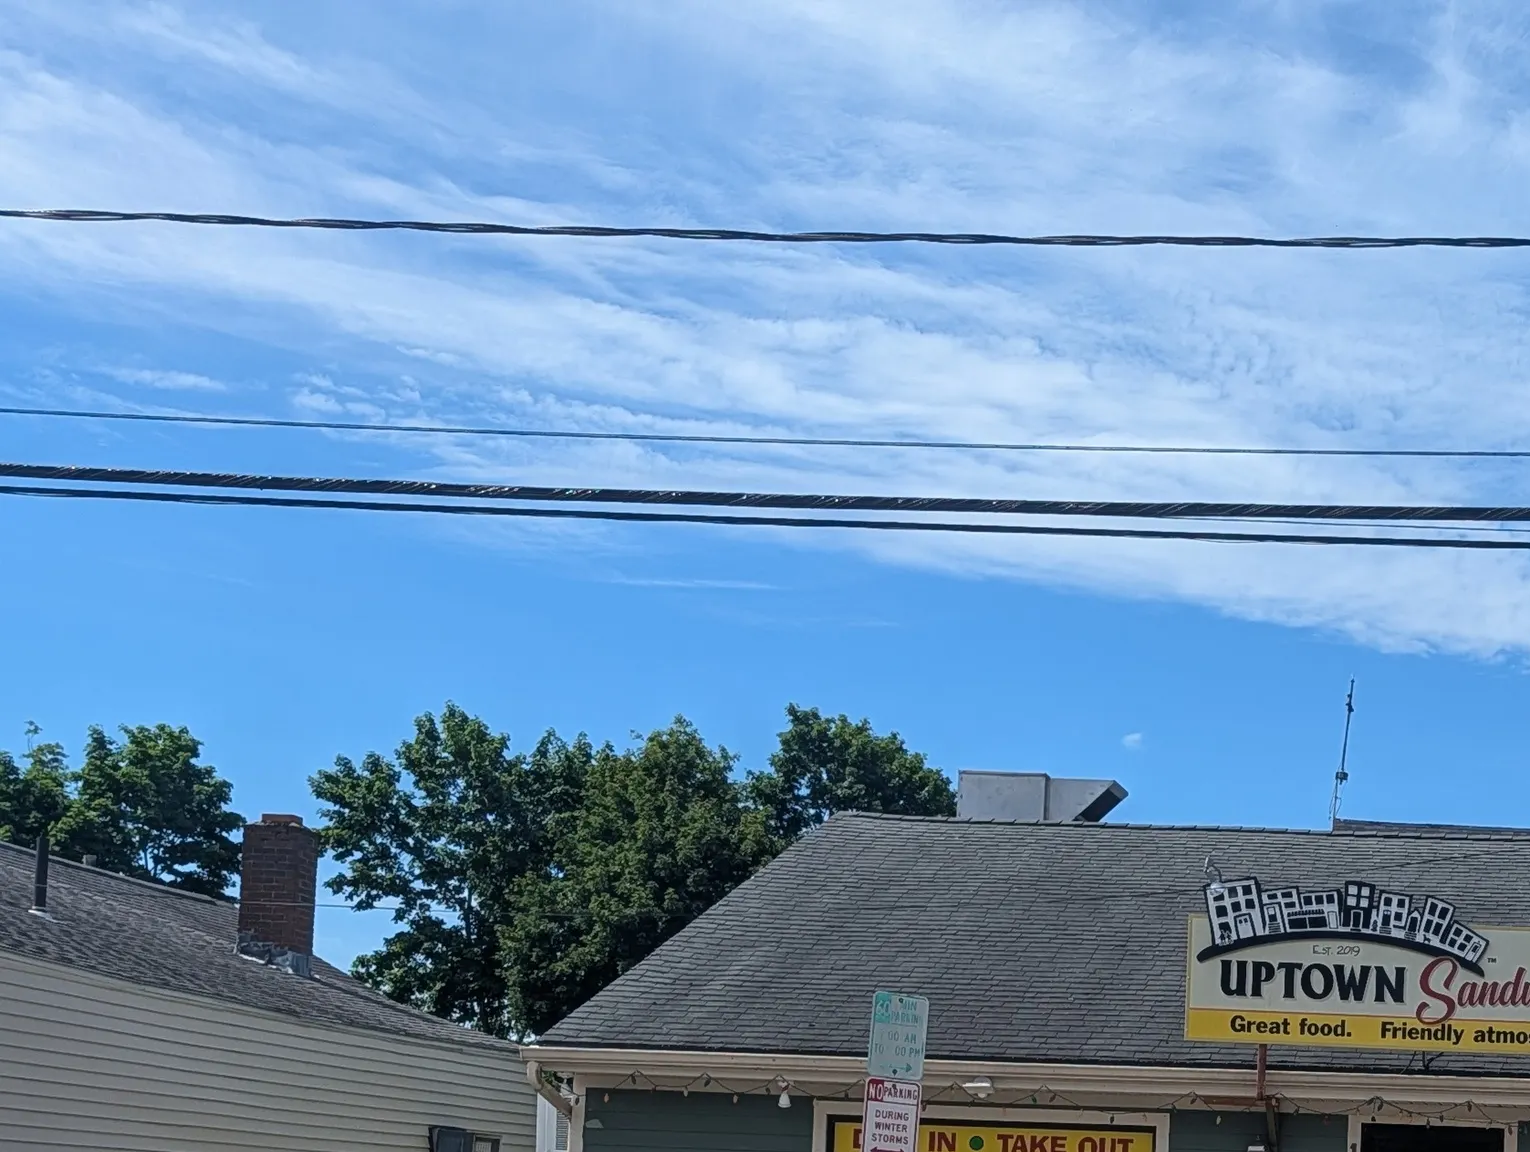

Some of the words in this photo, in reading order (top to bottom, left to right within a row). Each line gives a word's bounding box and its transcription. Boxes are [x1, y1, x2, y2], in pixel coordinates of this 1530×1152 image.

[1312, 944, 1334, 955] EST.
[1336, 946, 1360, 956] 2019
[1220, 959, 1407, 1003] UPTOWN
[1230, 1015, 1290, 1035] Great
[1299, 1018, 1352, 1038] food.
[1380, 1021, 1465, 1046] Friendly
[904, 1033, 917, 1044] AM
[909, 1047, 921, 1059] PM
[868, 1083, 884, 1100] NO
[884, 1086, 918, 1101] PARKING
[875, 1109, 910, 1122] DURING
[874, 1121, 908, 1133] WINTER
[871, 1132, 909, 1145] STORMS
[928, 1131, 957, 1152] IN
